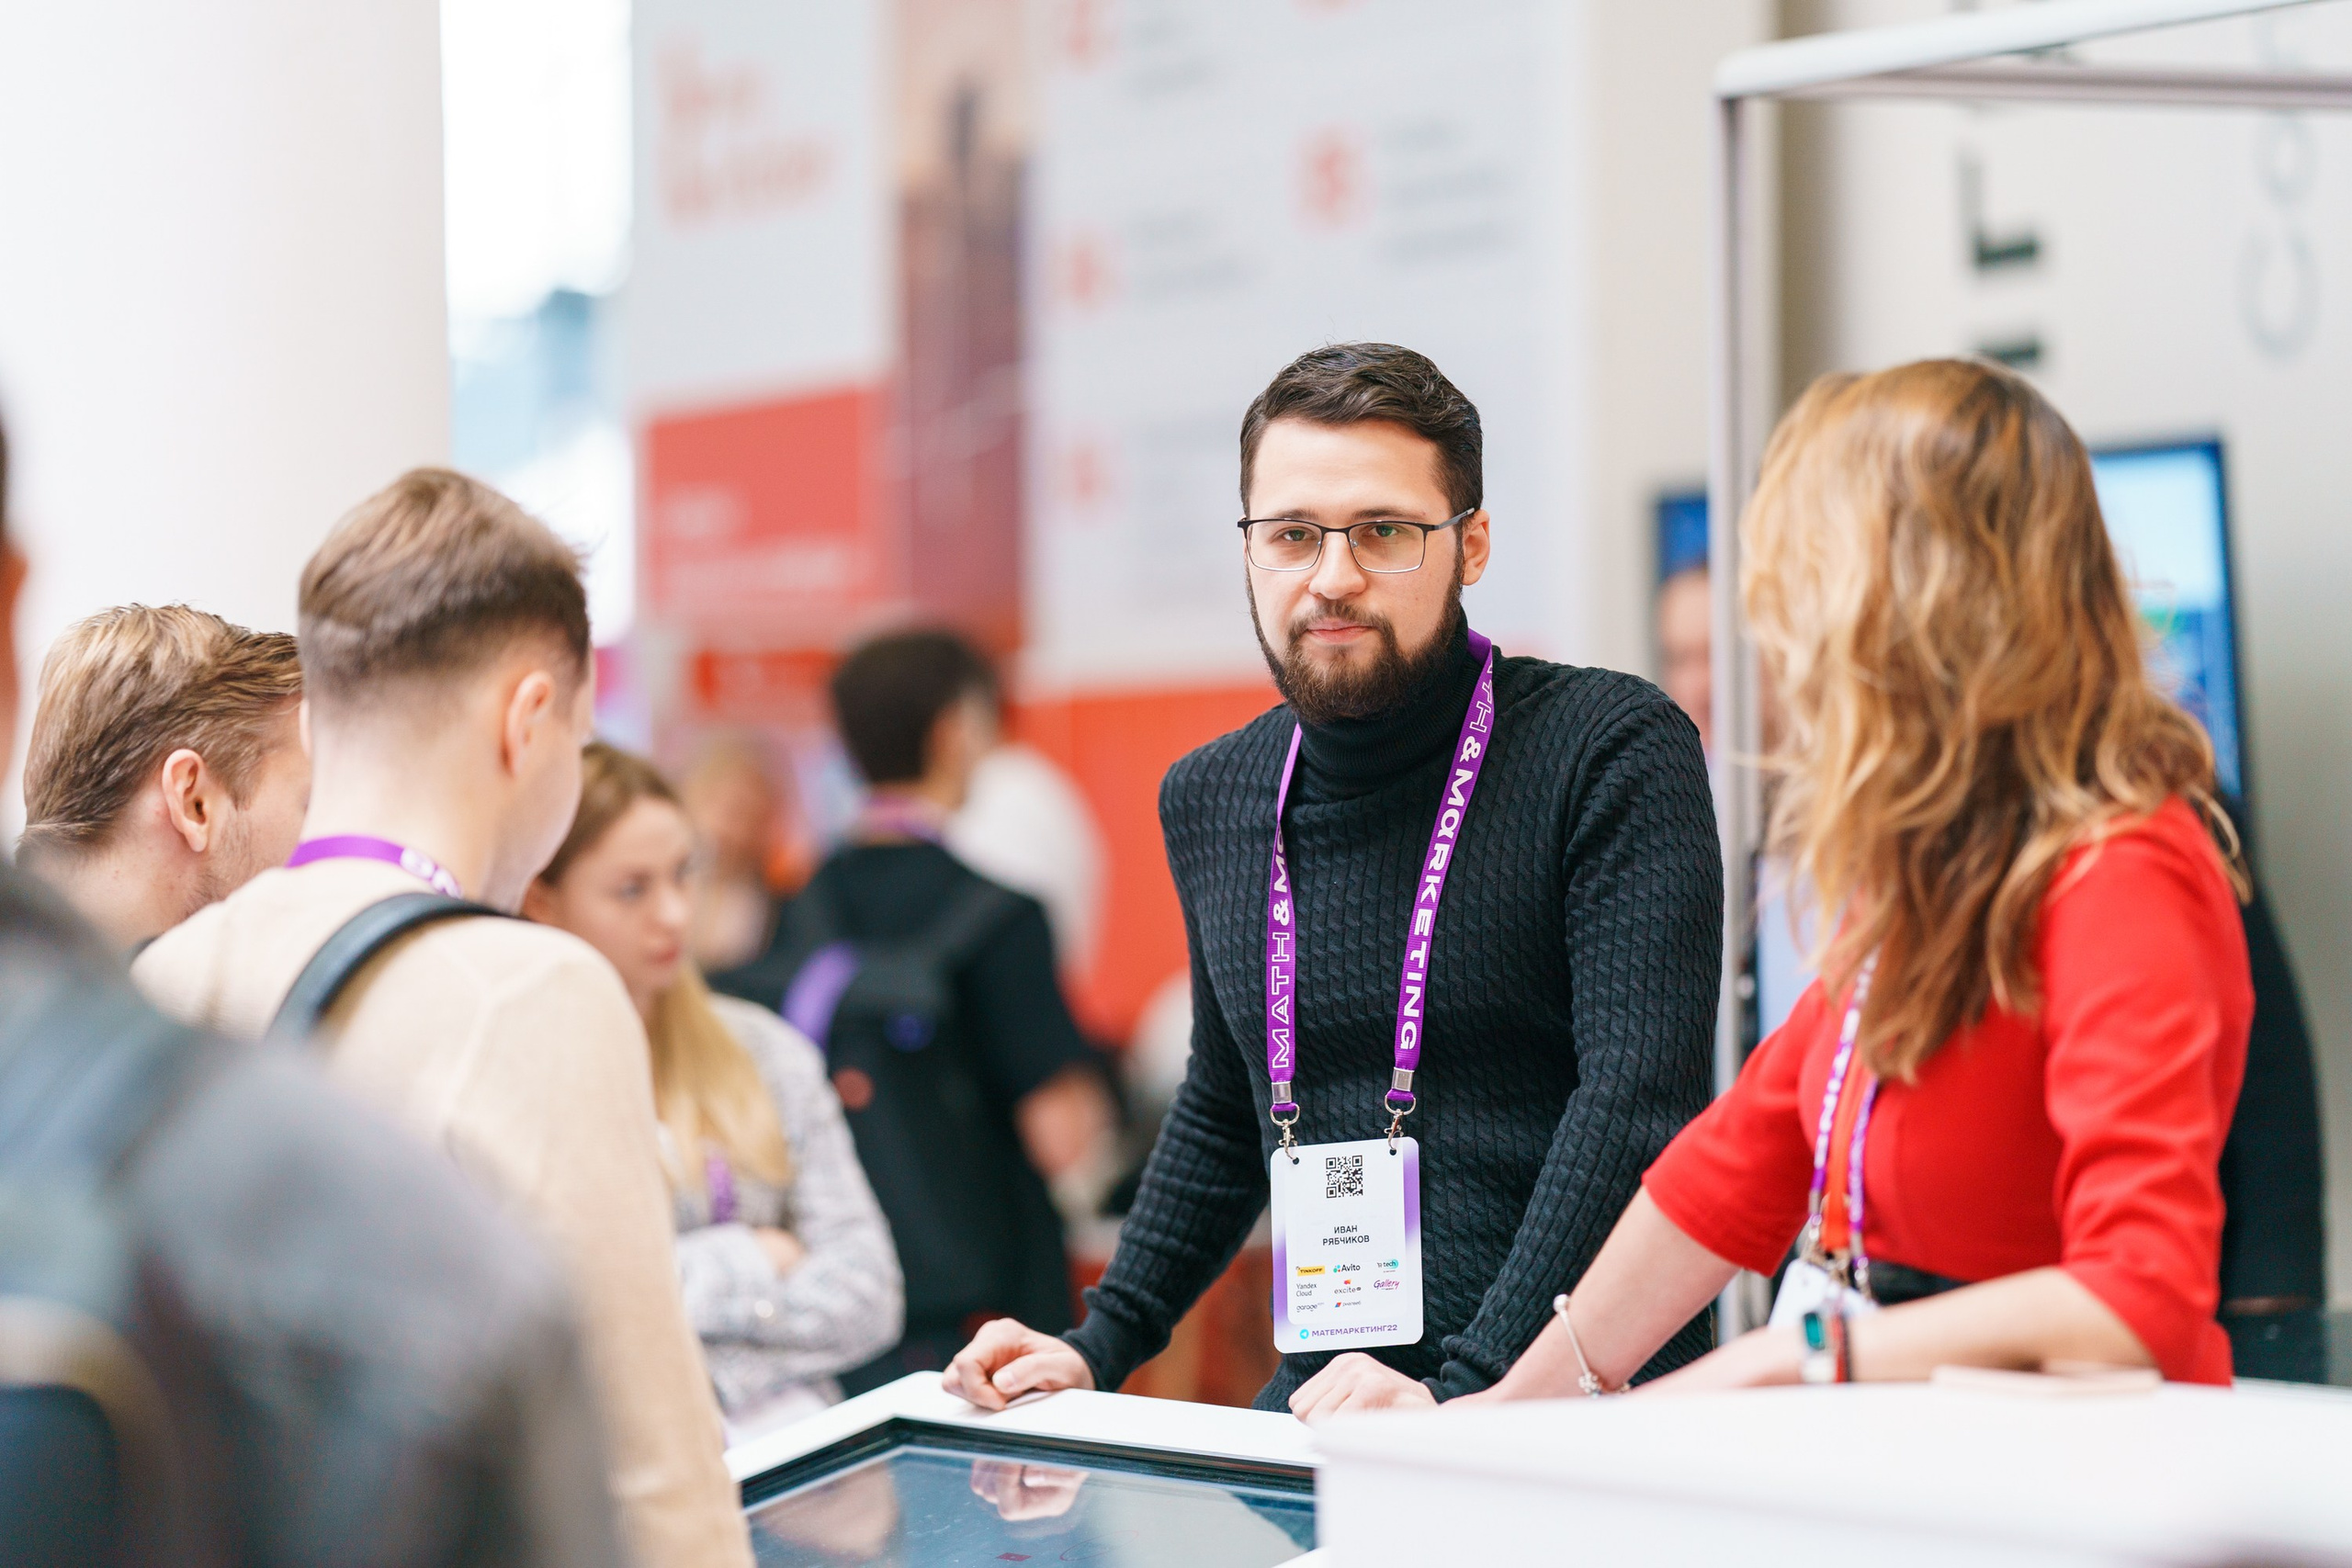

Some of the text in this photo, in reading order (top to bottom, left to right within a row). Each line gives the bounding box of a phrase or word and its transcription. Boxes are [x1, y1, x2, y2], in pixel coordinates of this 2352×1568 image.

[1460, 736, 1481, 762] &
[1272, 898, 1288, 927] &
[1272, 931, 1290, 1069] MATH
[1334, 1225, 1358, 1235] ИВАН
[1323, 1235, 1370, 1246] РЯБЧИКОВ
[1341, 1263, 1361, 1272] Avito
[1334, 1286, 1356, 1294] excite
[1374, 1280, 1400, 1291] Gallery
[1311, 1324, 1397, 1337] МАТЕМАРКЕТИНГ22
